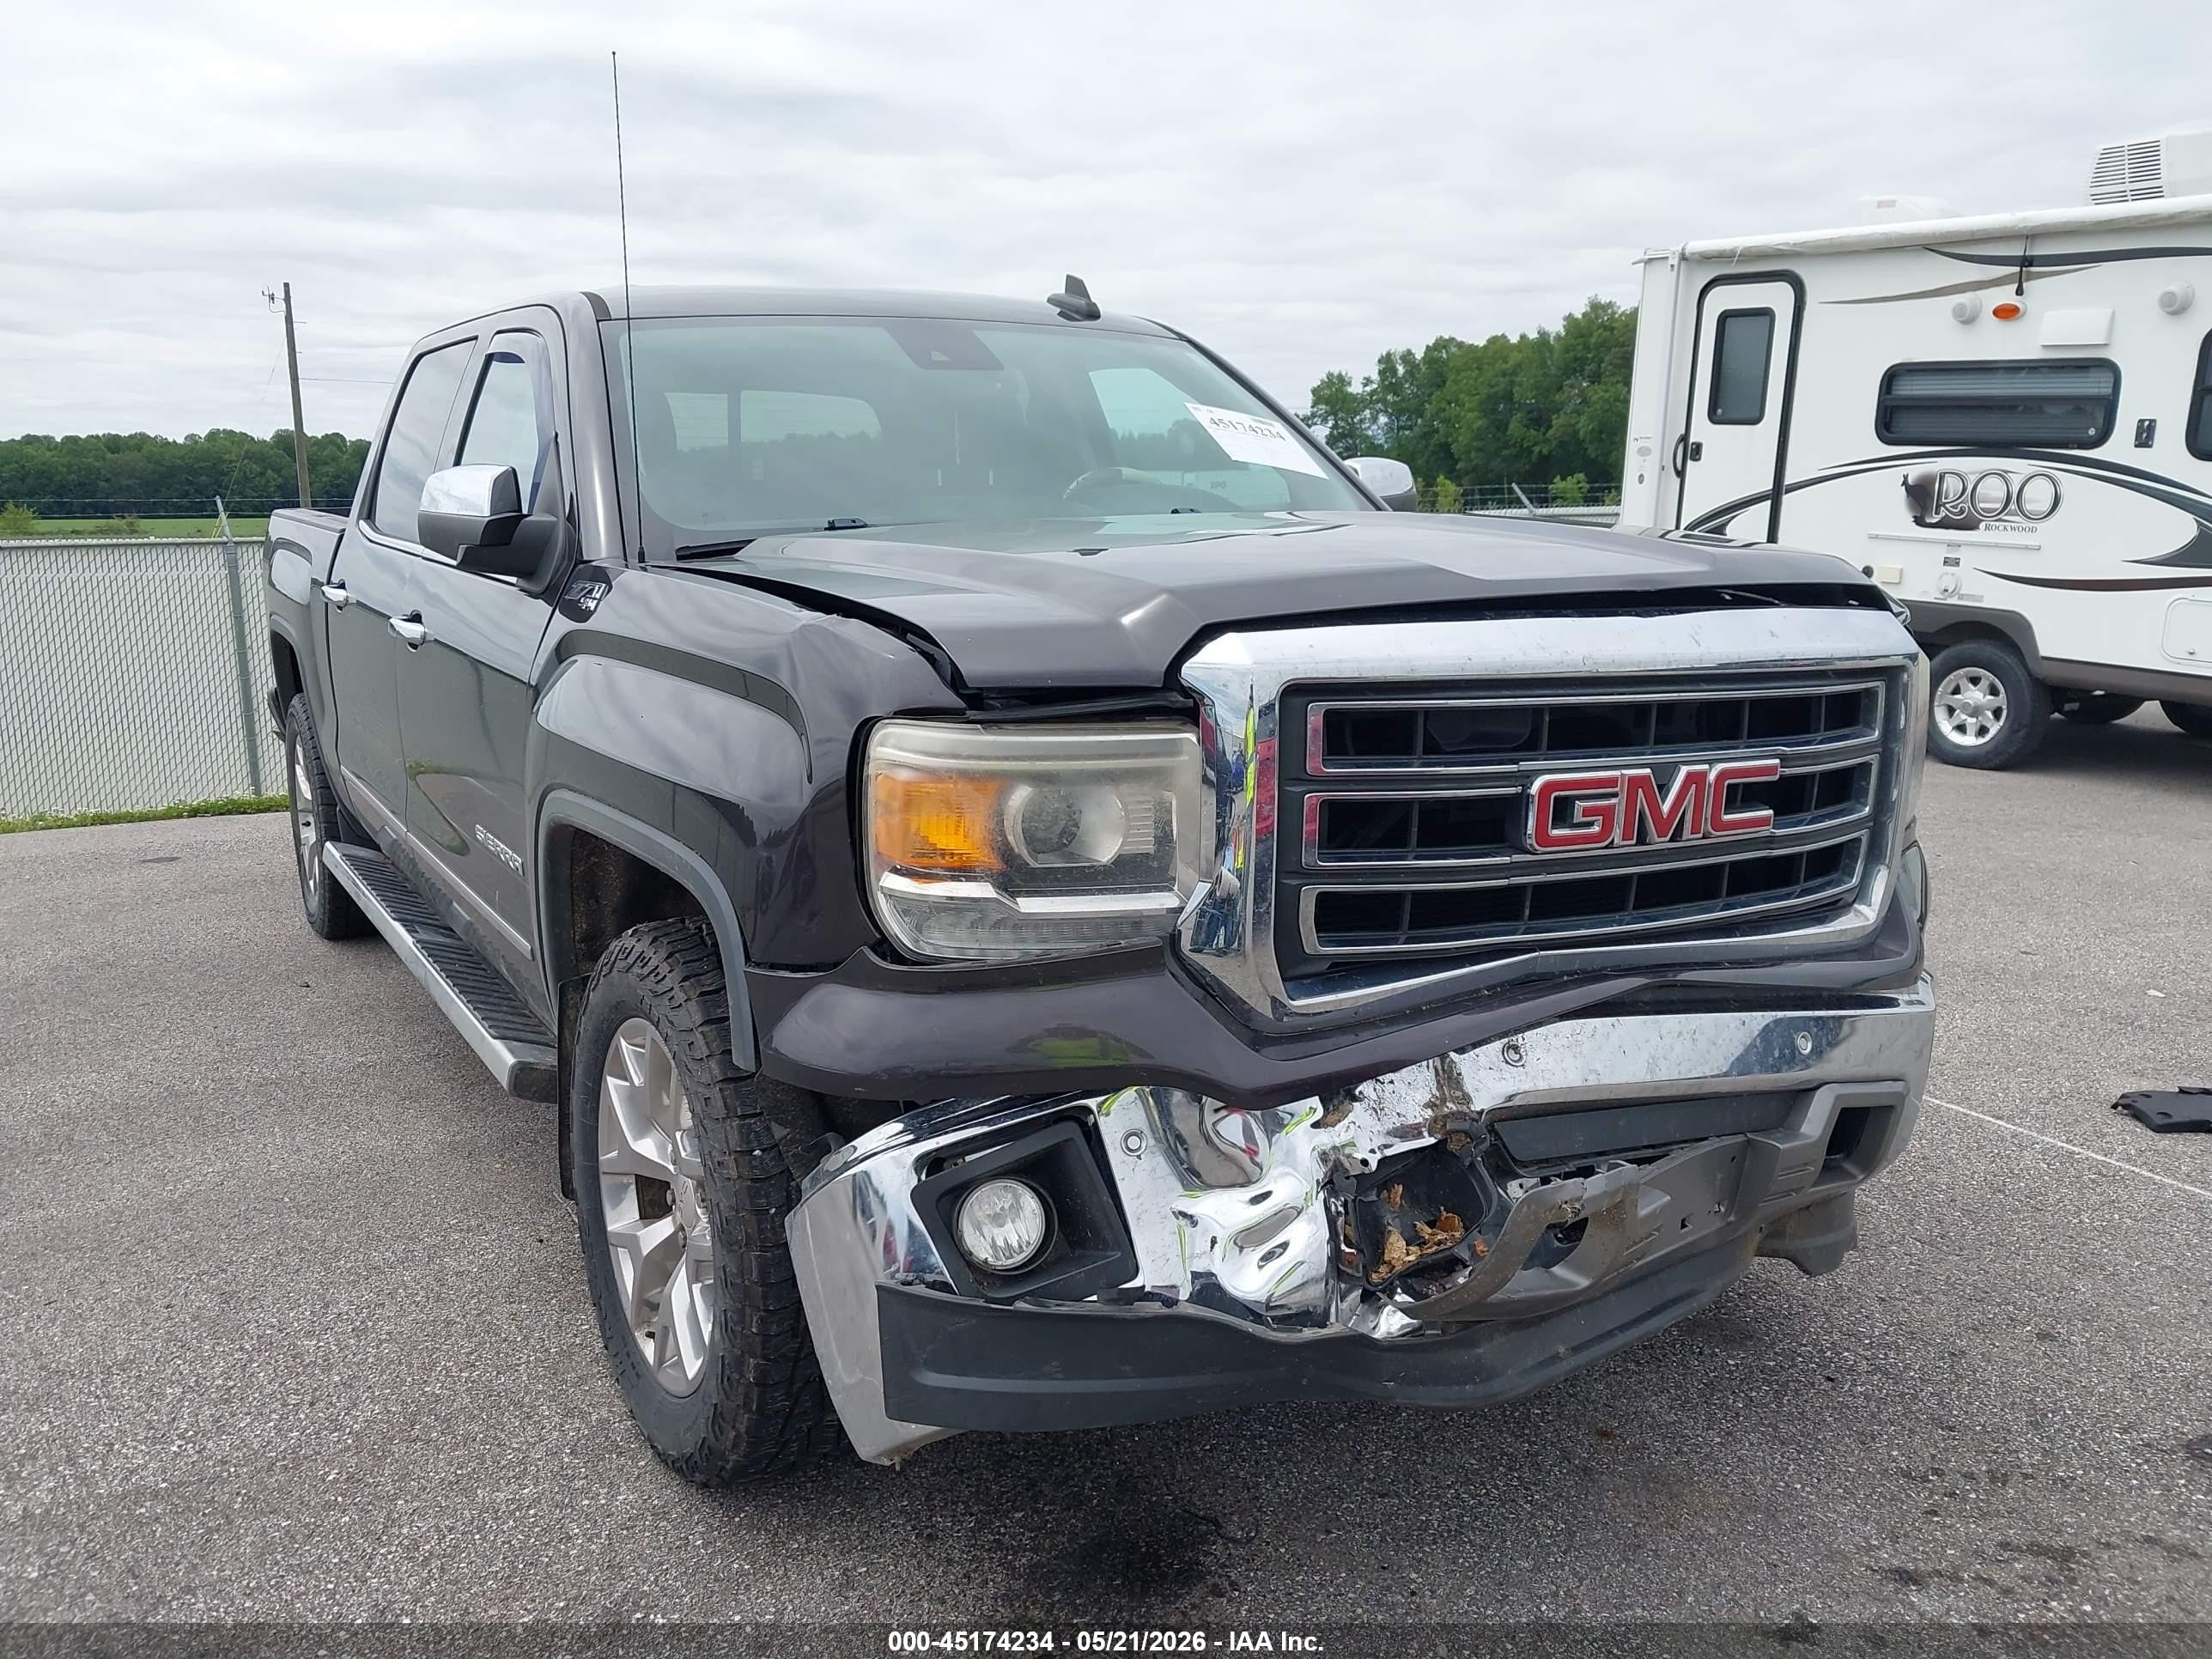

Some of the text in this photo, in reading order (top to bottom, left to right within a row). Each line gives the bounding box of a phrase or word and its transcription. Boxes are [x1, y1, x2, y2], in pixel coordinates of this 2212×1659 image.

[1209, 417, 1286, 441] 45174234
[1933, 470, 2063, 523] ROO
[1984, 523, 2038, 533] ROCKWOOD
[1527, 758, 1781, 854] GMC
[474, 823, 526, 877] SIERRA
